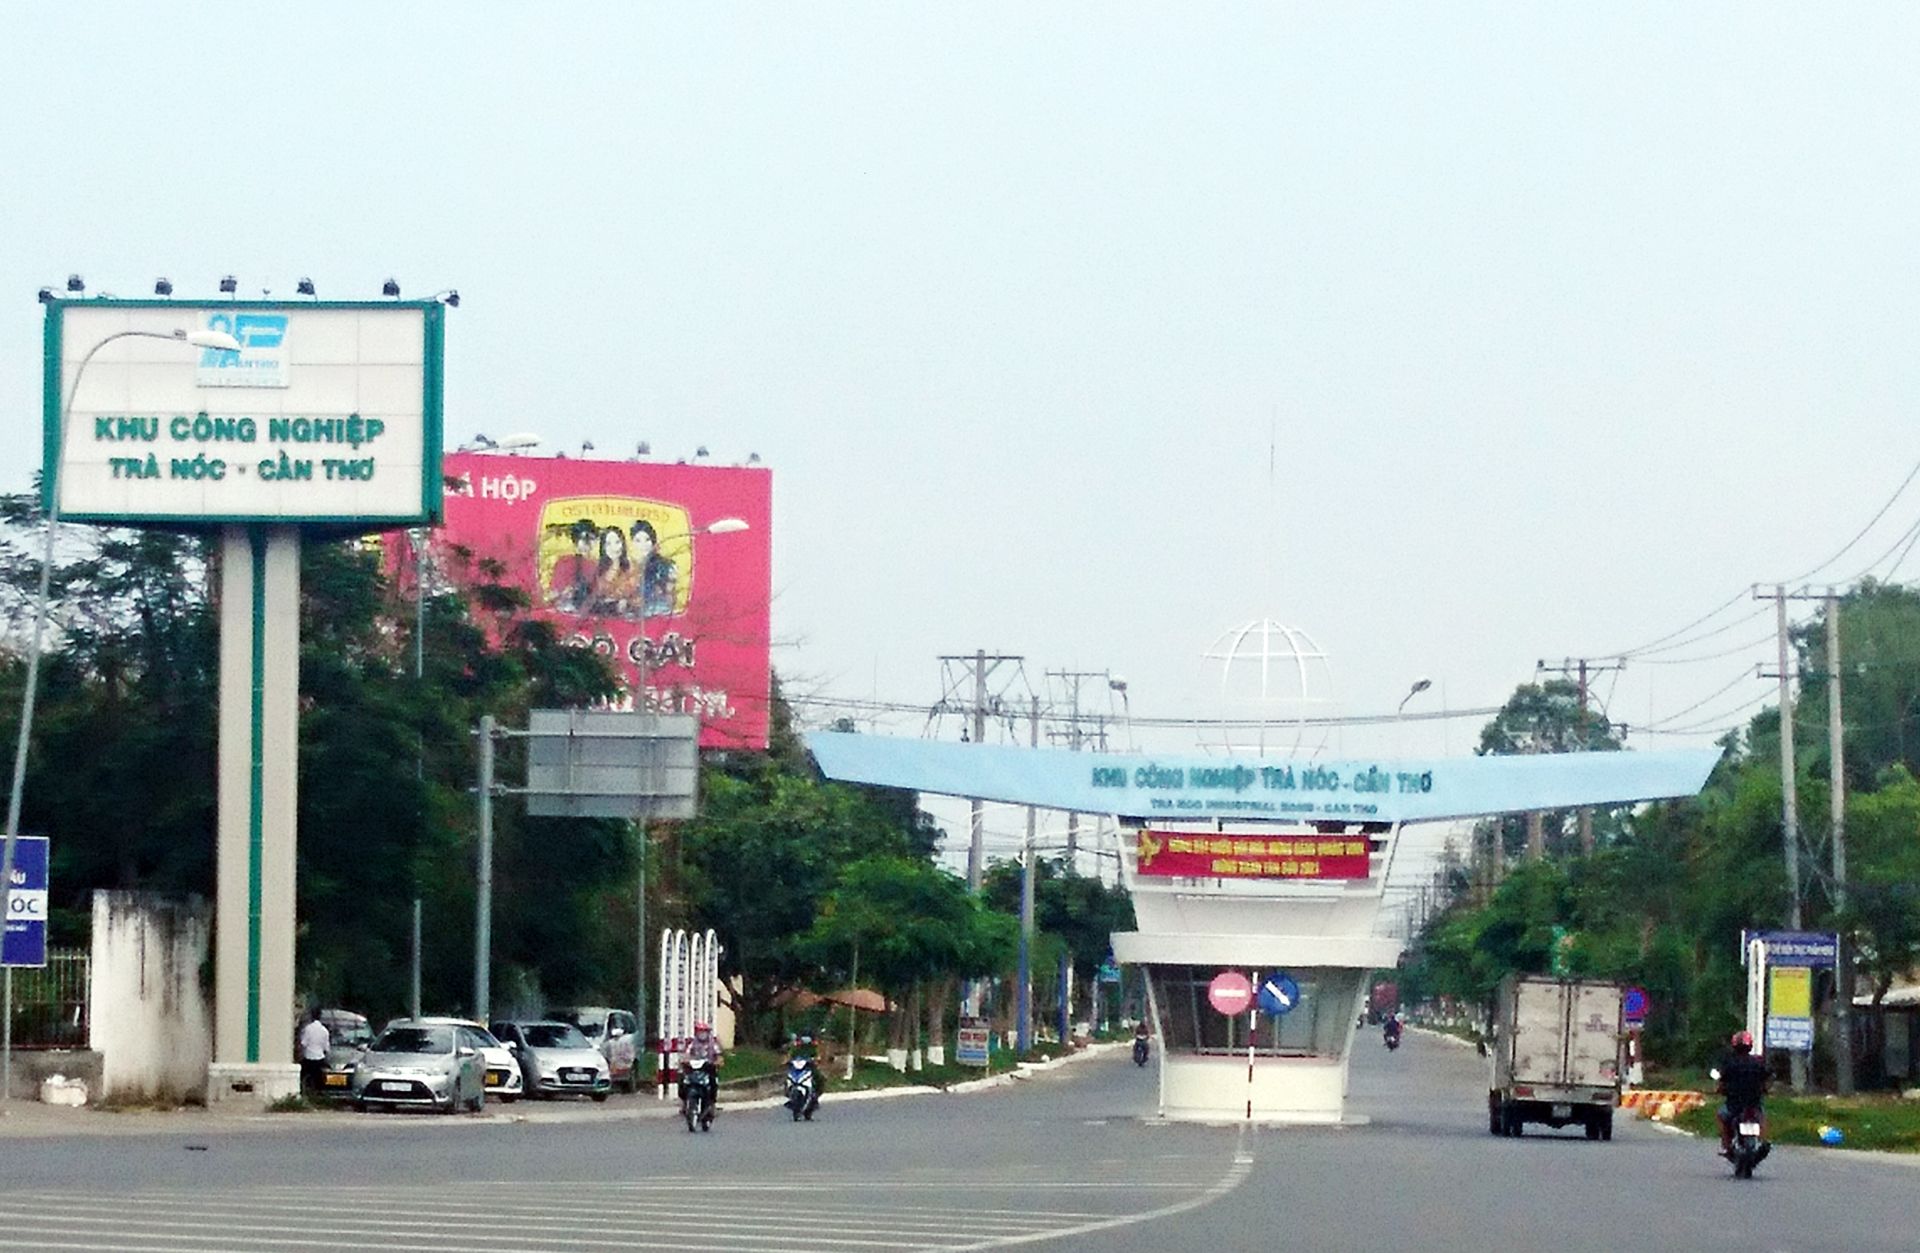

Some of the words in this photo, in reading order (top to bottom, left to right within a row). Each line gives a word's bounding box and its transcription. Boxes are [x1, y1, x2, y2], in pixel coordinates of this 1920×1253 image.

[95, 416, 159, 442] KHU
[170, 411, 257, 443] CÔNG
[269, 413, 385, 450] NGHIỆP
[109, 452, 161, 479] TRÀ
[171, 453, 226, 481] NÓC
[258, 449, 313, 481] CẦN
[322, 456, 375, 481] THƠ
[481, 473, 537, 506] HỘP
[1261, 765, 1296, 790] TRÀ
[1302, 765, 1339, 792] NÓC
[1397, 770, 1432, 793] THƠ
